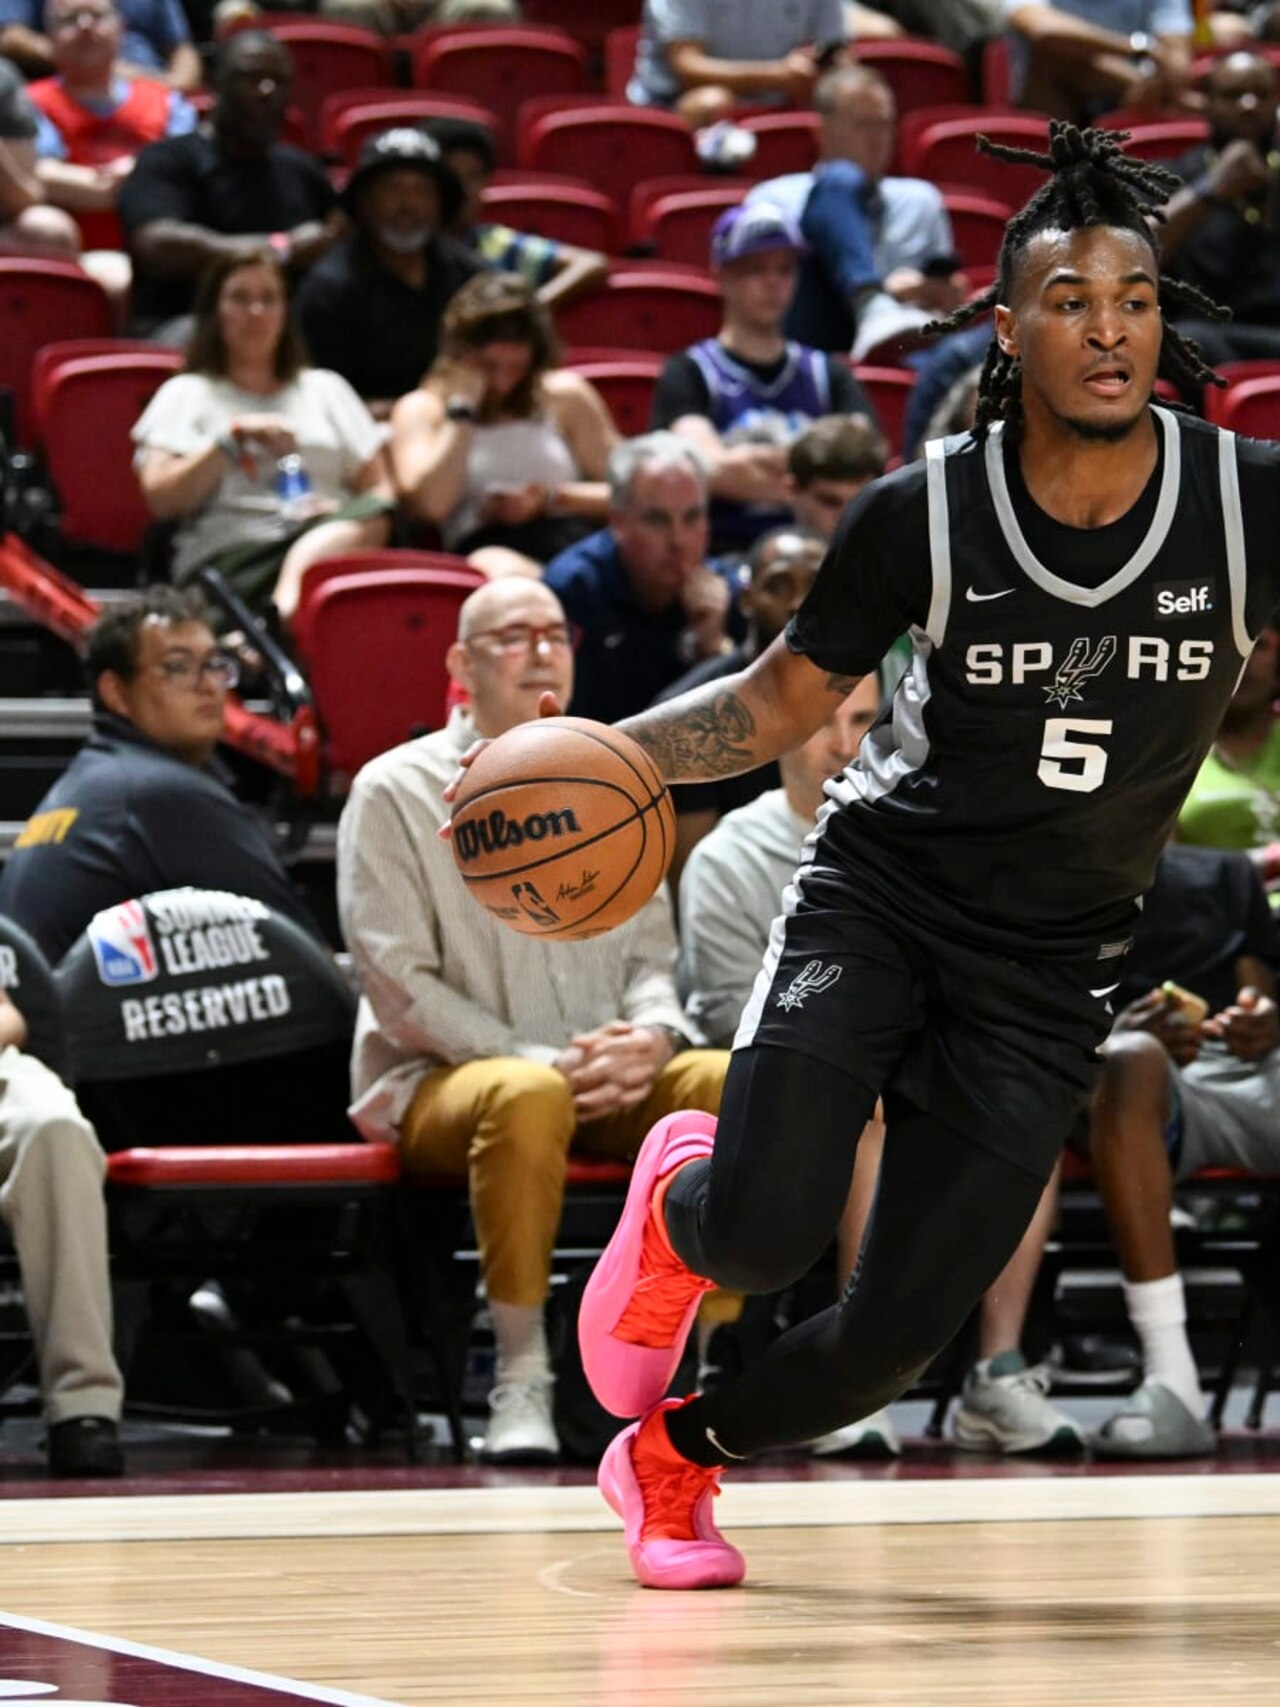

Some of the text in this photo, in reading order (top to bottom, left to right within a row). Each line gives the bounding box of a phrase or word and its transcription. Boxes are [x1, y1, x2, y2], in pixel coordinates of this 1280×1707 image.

[1156, 586, 1214, 615] Self.
[1036, 717, 1113, 793] 5
[453, 808, 583, 862] Wilson
[160, 920, 270, 976] LEAGUE
[121, 974, 291, 1041] RESERVED
